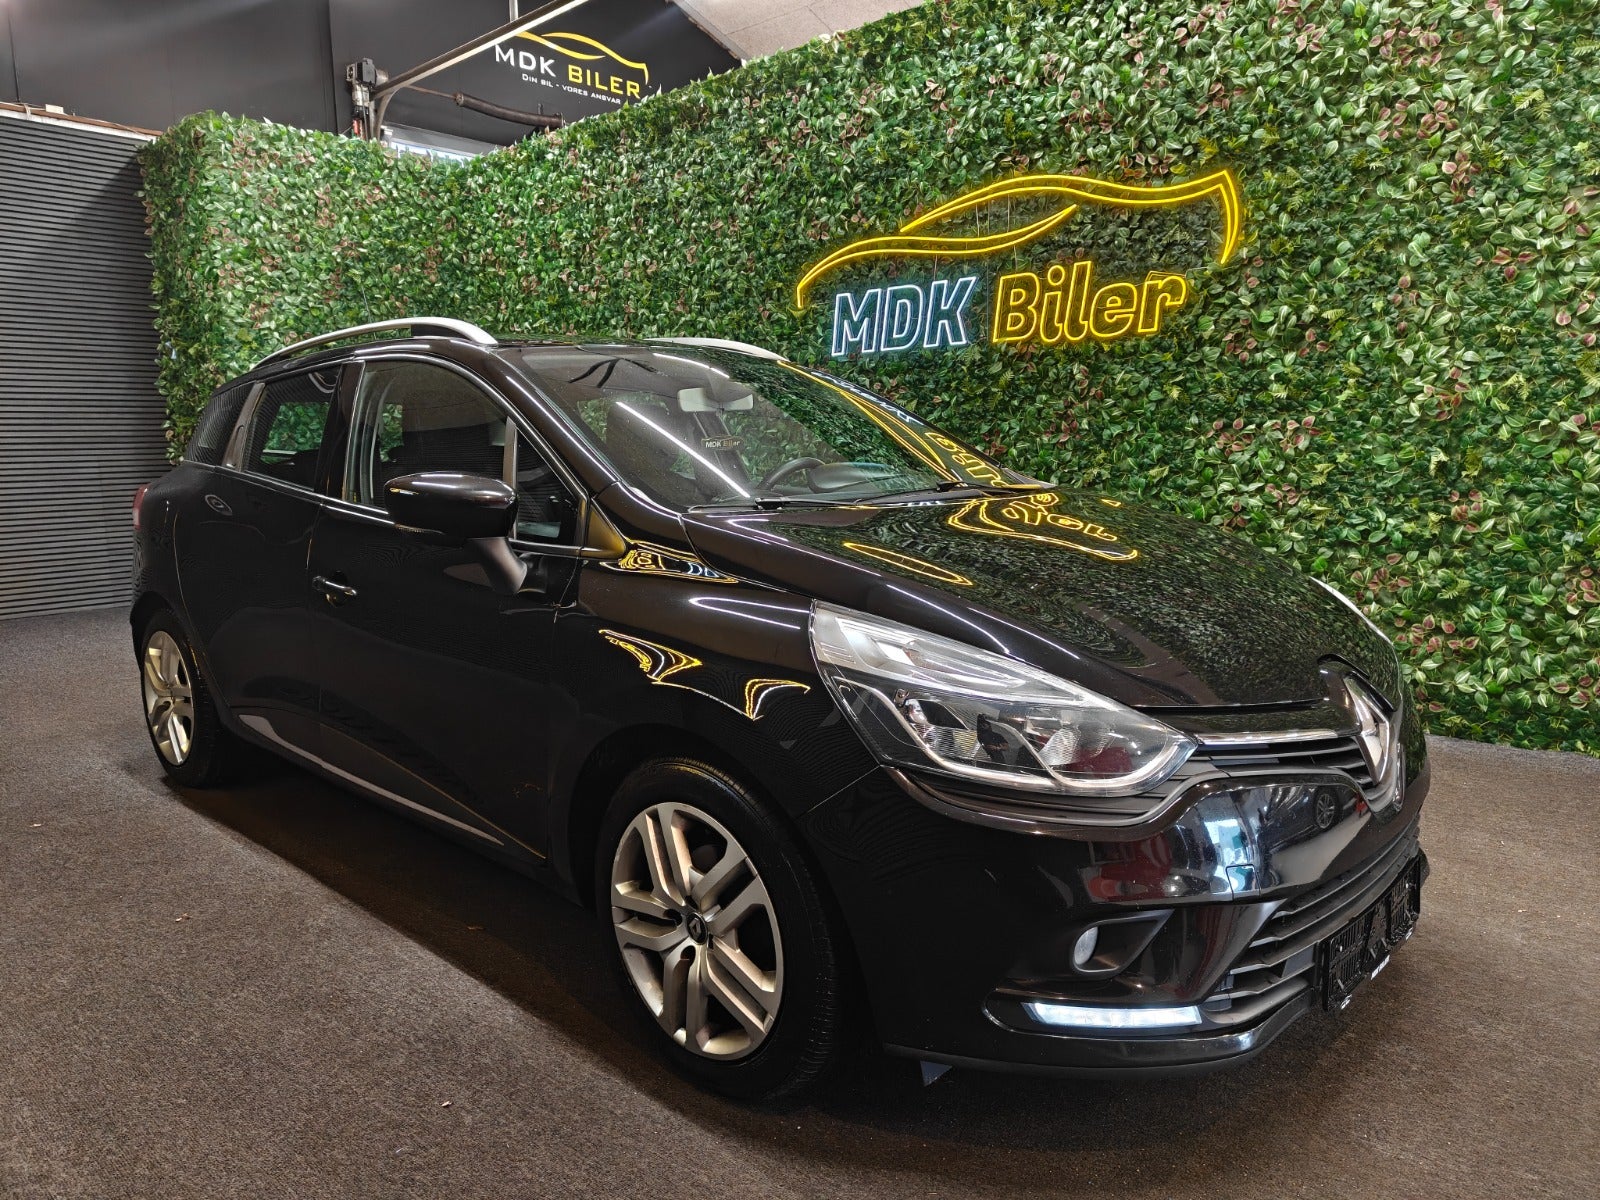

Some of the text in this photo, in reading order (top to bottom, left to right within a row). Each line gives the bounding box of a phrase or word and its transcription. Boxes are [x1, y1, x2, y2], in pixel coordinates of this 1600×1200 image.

[494, 43, 641, 99] MDK BILER
[831, 260, 1188, 357] MDK Biler
[705, 440, 721, 448] MDK
